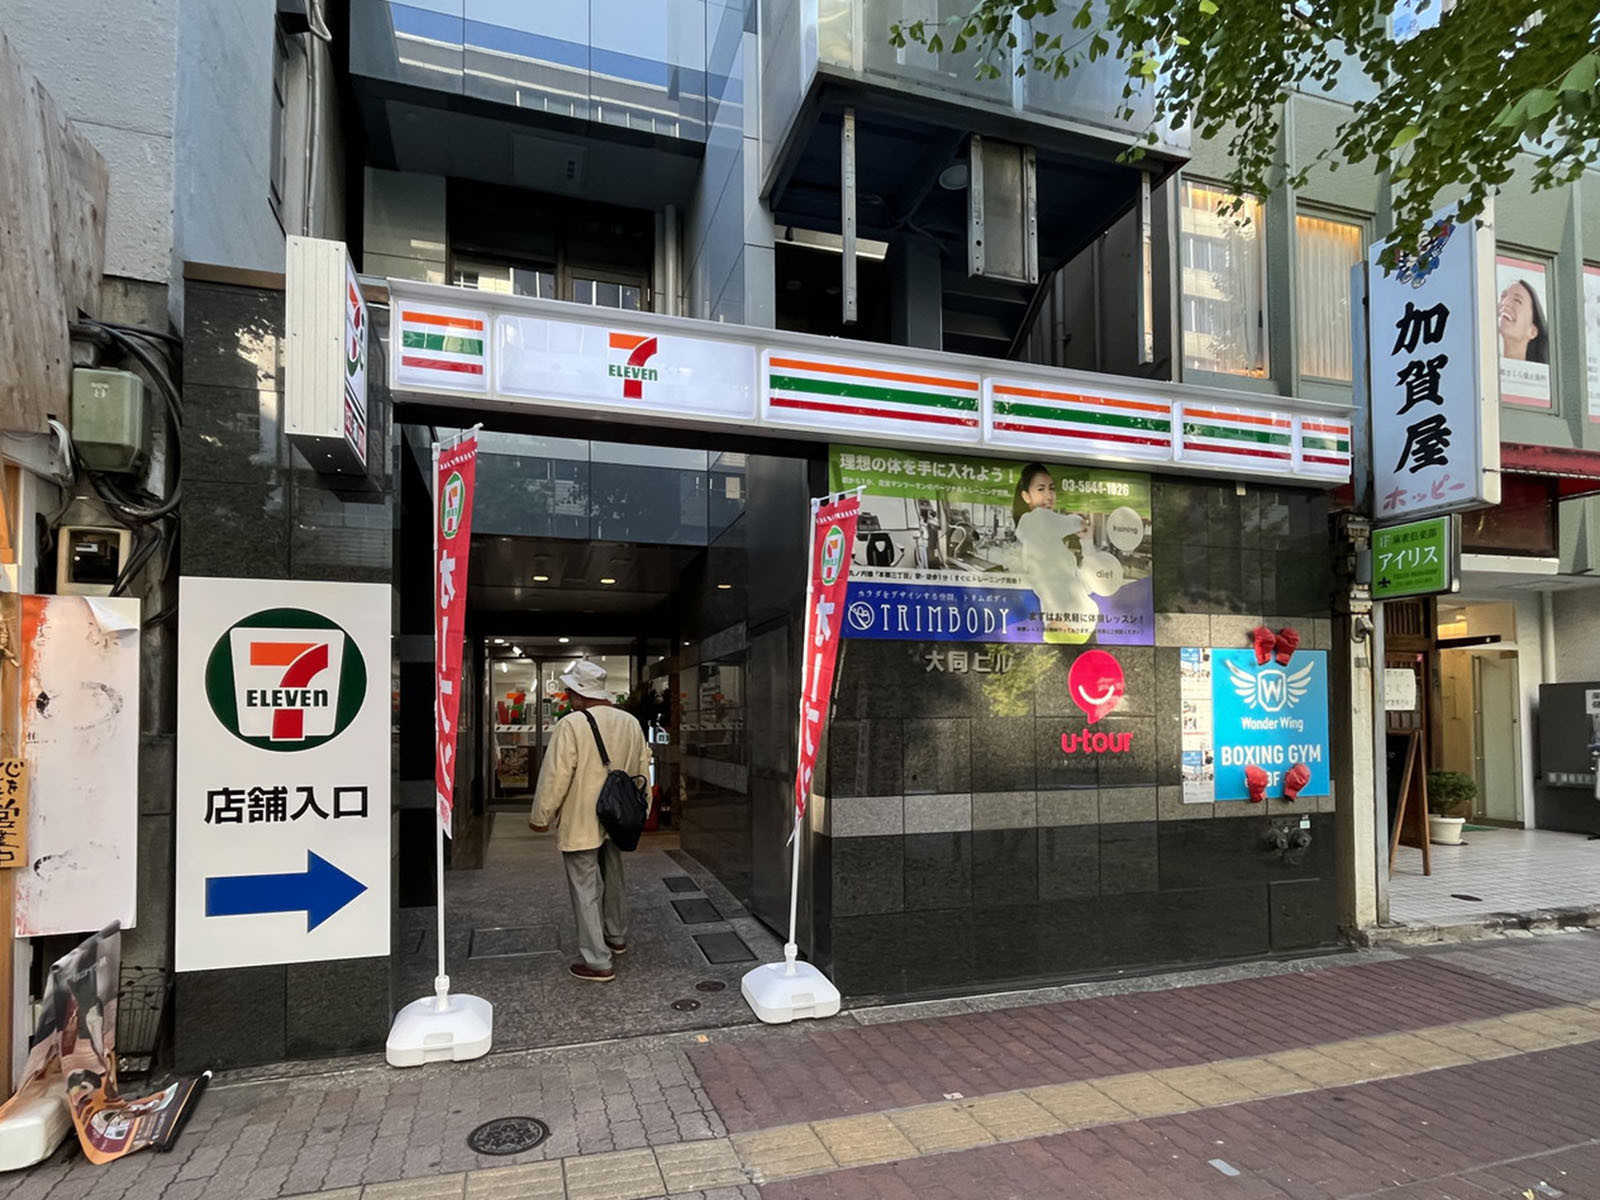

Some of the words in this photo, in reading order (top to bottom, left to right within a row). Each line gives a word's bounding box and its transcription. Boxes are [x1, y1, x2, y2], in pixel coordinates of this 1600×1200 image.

[1391, 300, 1452, 474] 加賀屋
[1383, 473, 1466, 511] ホッピー
[1378, 545, 1439, 573] アイリス
[1096, 568, 1113, 580] diet
[880, 604, 1010, 635] TRIMBODY
[925, 650, 1014, 674] 大同ビル
[1241, 717, 1279, 730] Wonder
[1280, 717, 1304, 733] Wing
[1061, 730, 1134, 755] u-tour
[1221, 745, 1284, 766] BOXING
[1288, 744, 1322, 764] GYM
[204, 785, 369, 825] 店舗入口
